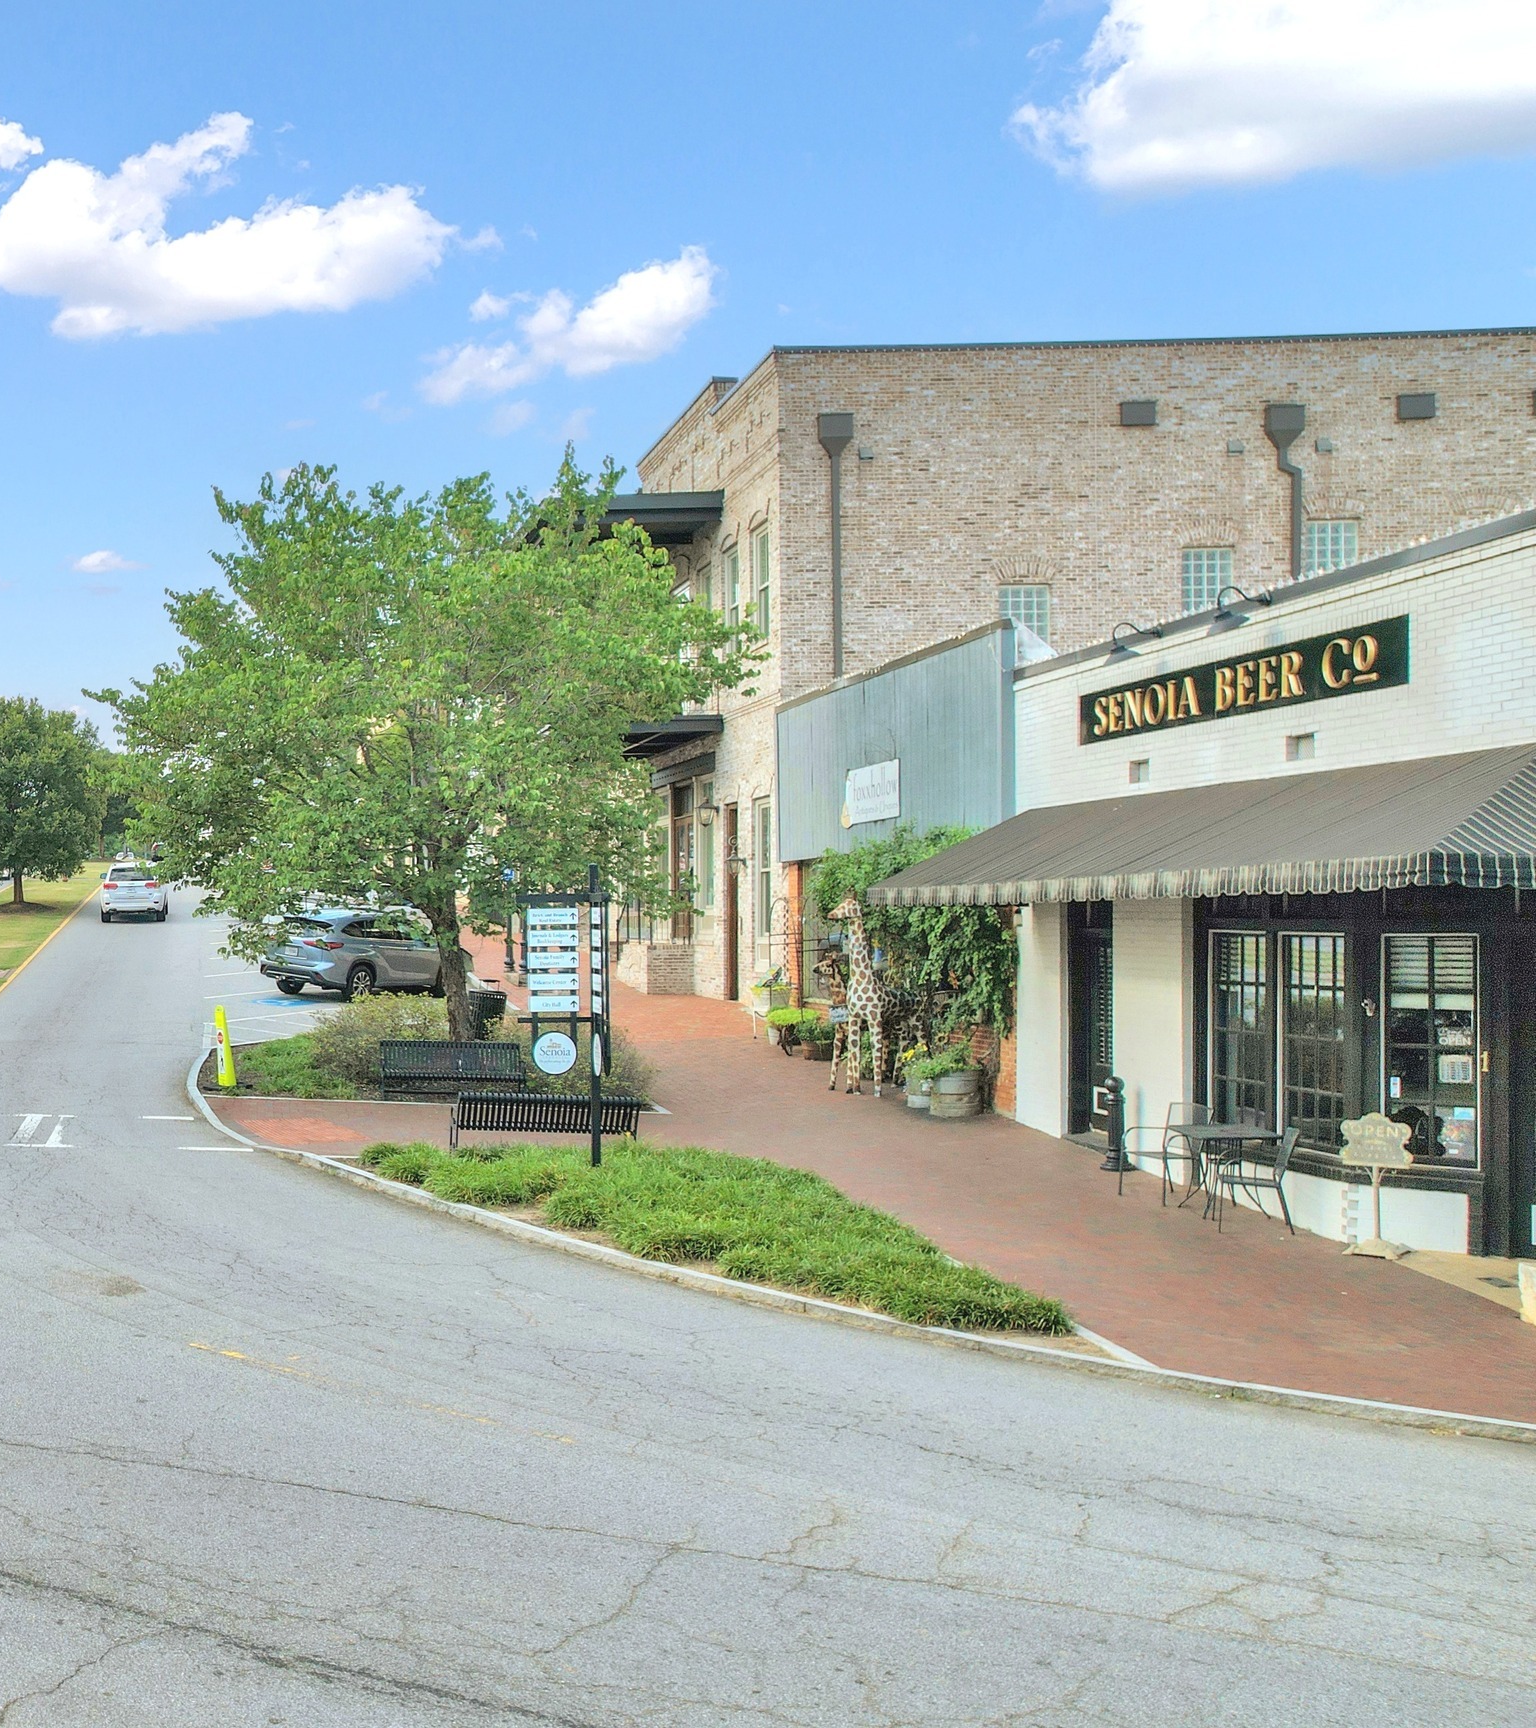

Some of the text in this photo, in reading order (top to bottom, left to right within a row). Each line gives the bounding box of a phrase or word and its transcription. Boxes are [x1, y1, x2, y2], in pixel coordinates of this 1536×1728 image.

[1093, 675, 1202, 736] SENOIA
[1215, 651, 1306, 712] BEER
[1438, 1036, 1473, 1046] OPEN
[539, 1045, 571, 1057] Senoia
[1350, 1125, 1399, 1138] OPEN
